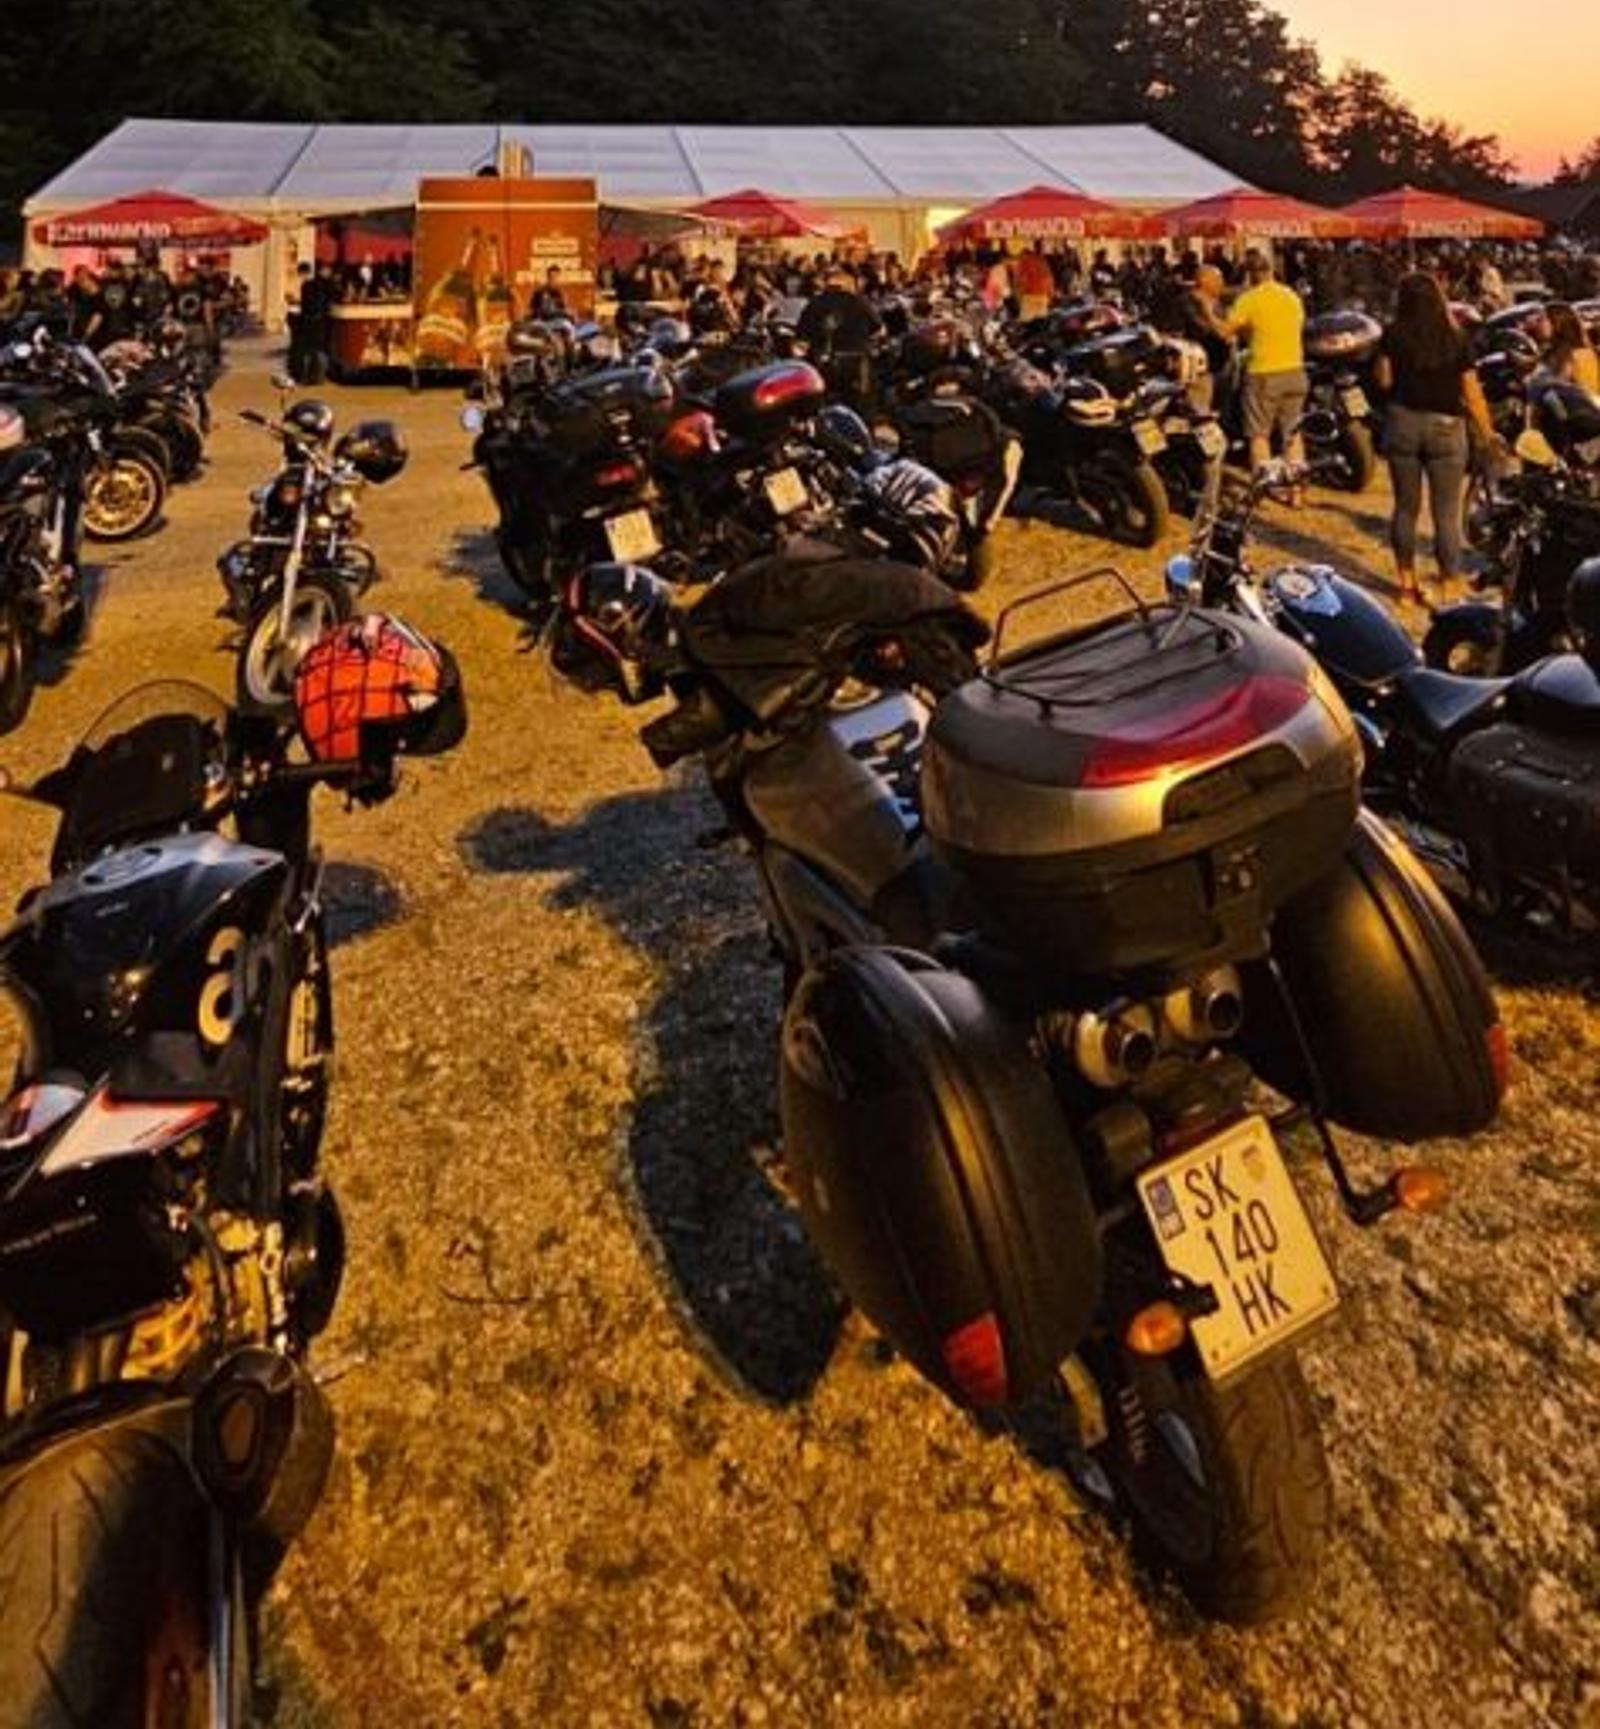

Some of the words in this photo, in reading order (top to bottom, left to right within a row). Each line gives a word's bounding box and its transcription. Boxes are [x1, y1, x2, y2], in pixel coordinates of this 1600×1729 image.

[1184, 1154, 1241, 1221] SK
[1205, 1199, 1279, 1279] 140
[1231, 1261, 1293, 1336] HK
